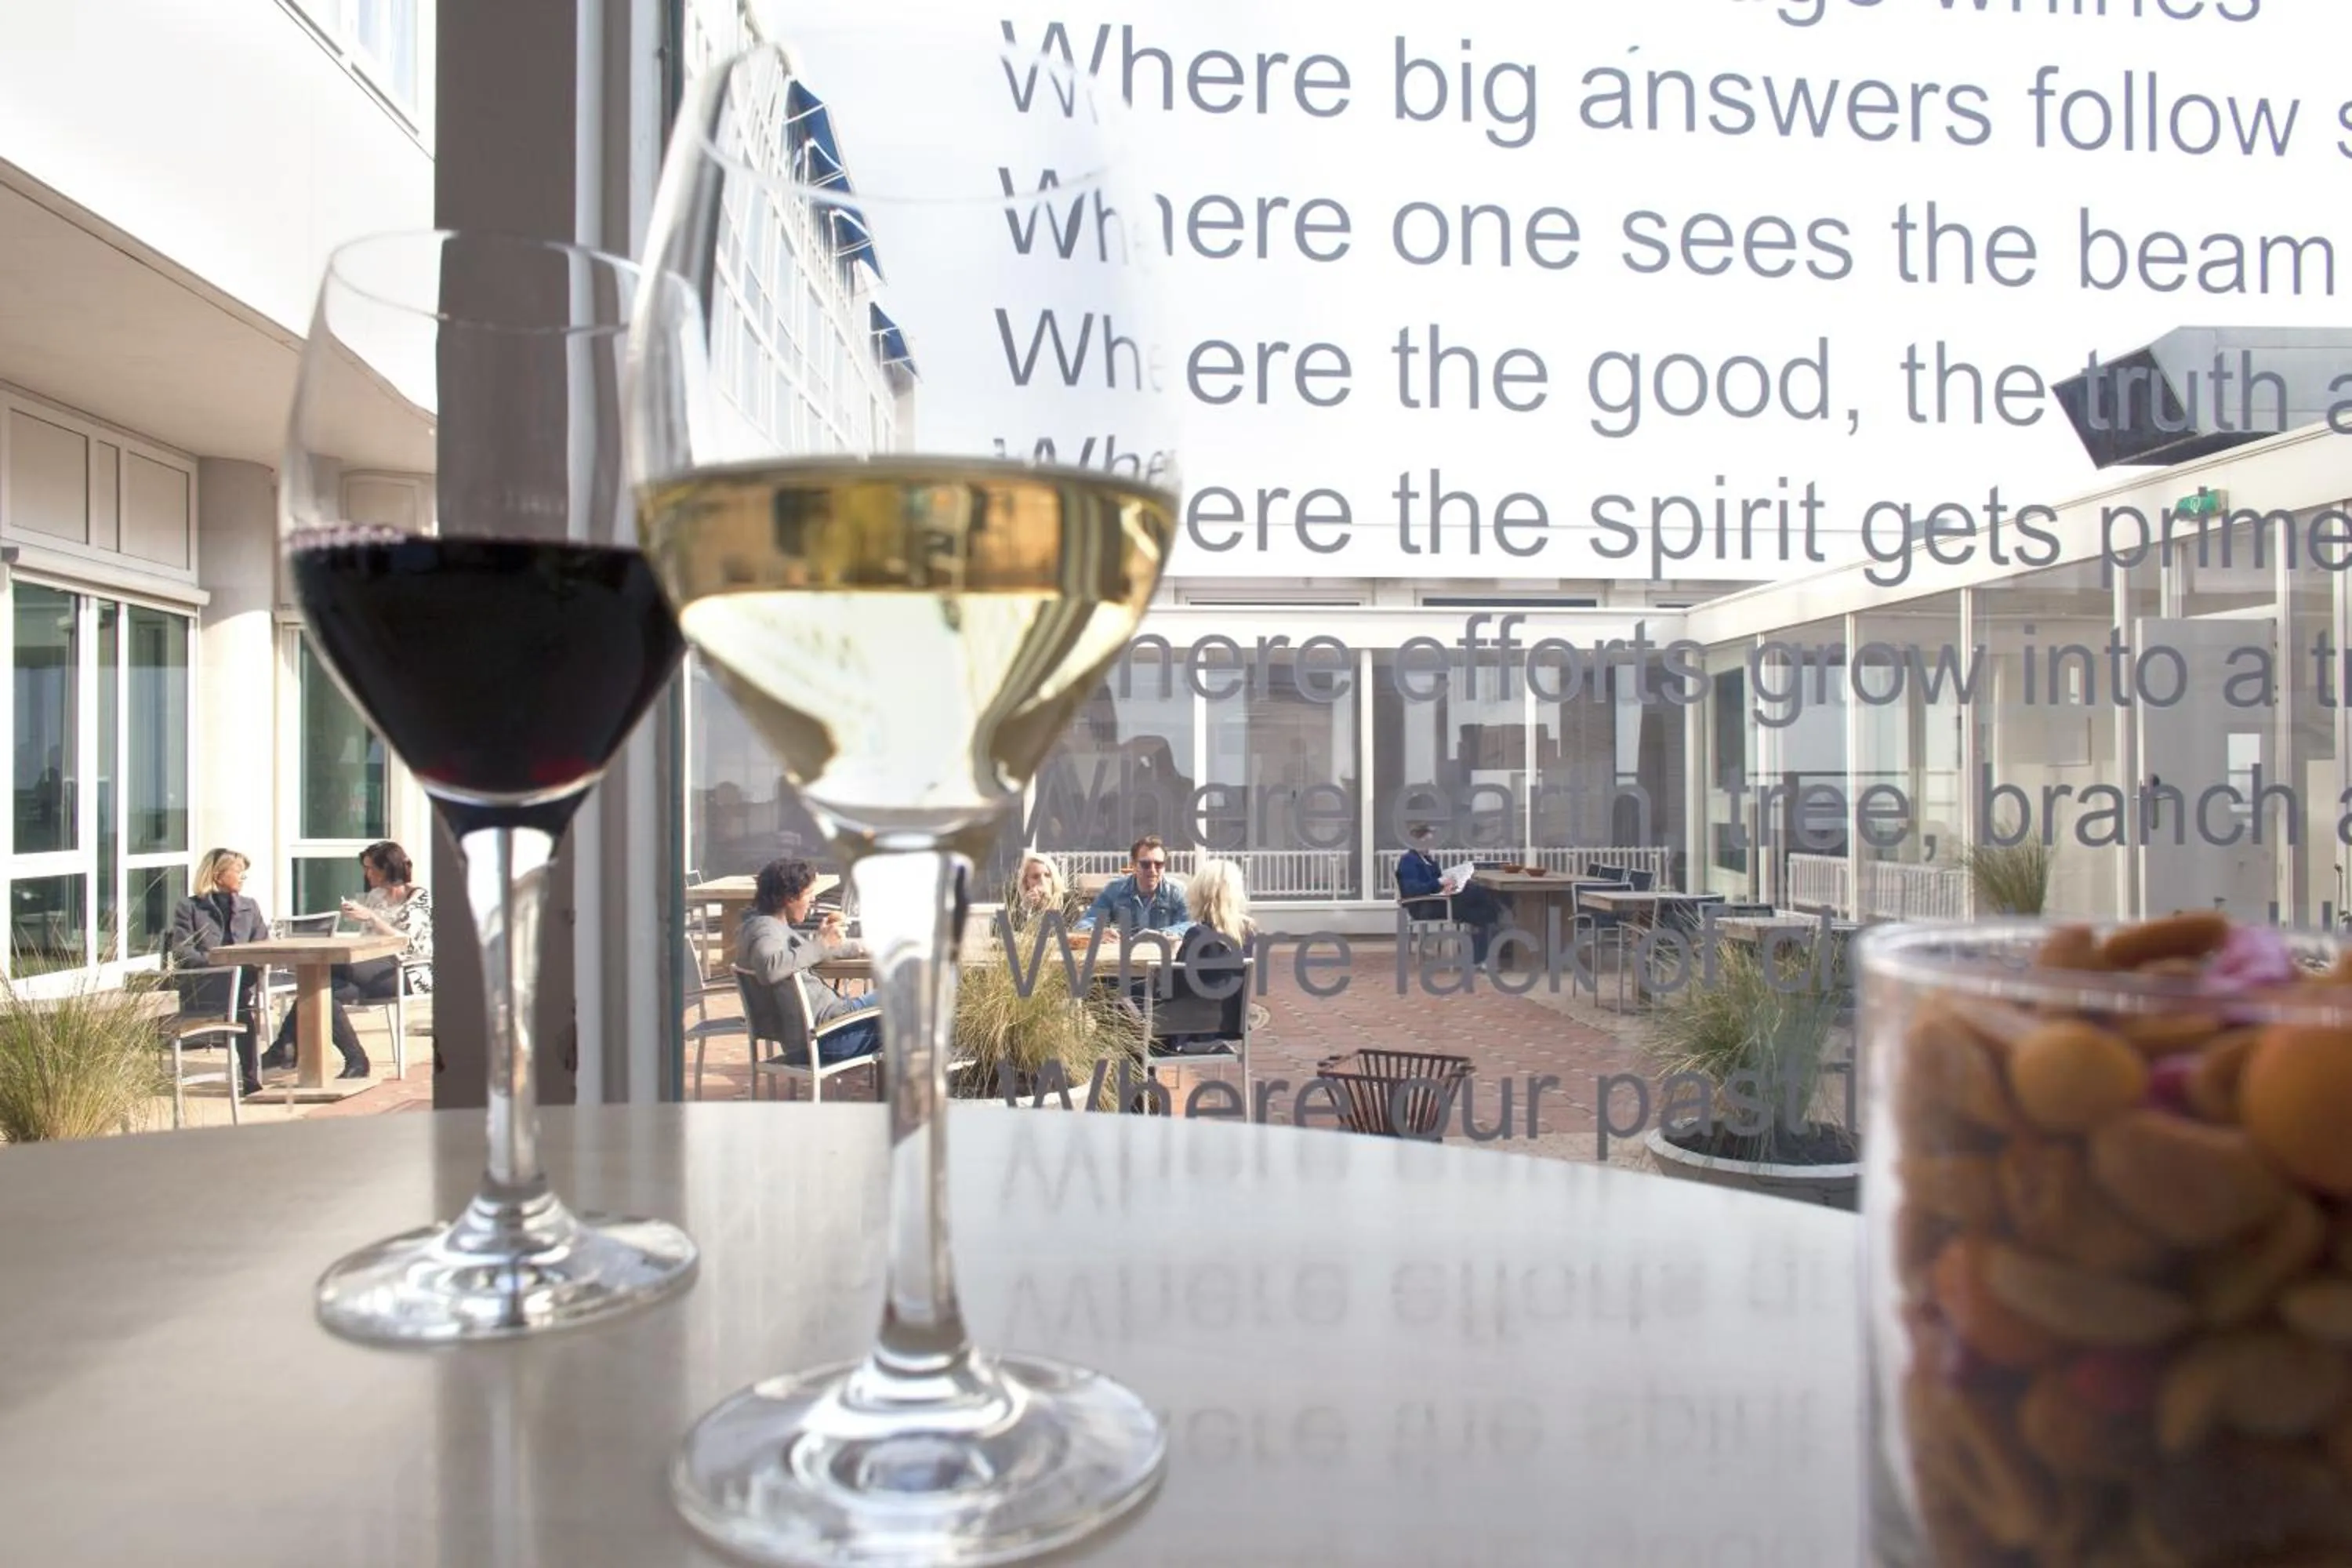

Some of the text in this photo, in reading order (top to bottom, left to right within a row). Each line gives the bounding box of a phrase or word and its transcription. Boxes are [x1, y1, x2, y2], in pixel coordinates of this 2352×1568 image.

[1000, 20, 1351, 118] Where
[1395, 35, 1537, 149] big
[2027, 65, 2300, 156] follow
[1392, 201, 1581, 270] one
[1622, 206, 1854, 280] sees
[1891, 201, 2037, 287] the
[2079, 207, 2335, 296] beam
[1391, 323, 1548, 411] the
[1588, 336, 1859, 438] good,
[1900, 339, 2045, 426] the
[2082, 348, 2287, 434] truth
[1391, 468, 1549, 557] the
[1589, 474, 1825, 581] spirit
[1861, 485, 2061, 587] gets
[1119, 633, 1352, 703] here
[1393, 615, 1711, 704] efforts
[1749, 639, 1984, 728] grow
[2022, 625, 2189, 709] into
[2223, 646, 2275, 709] a
[1726, 764, 1937, 855] tree,
[1980, 763, 2299, 847] branch
[996, 910, 1352, 998] Where
[1396, 909, 1597, 996] lack
[1634, 902, 1730, 996] of
[1391, 1073, 1559, 1141] our
[1597, 1047, 1811, 1160] past
